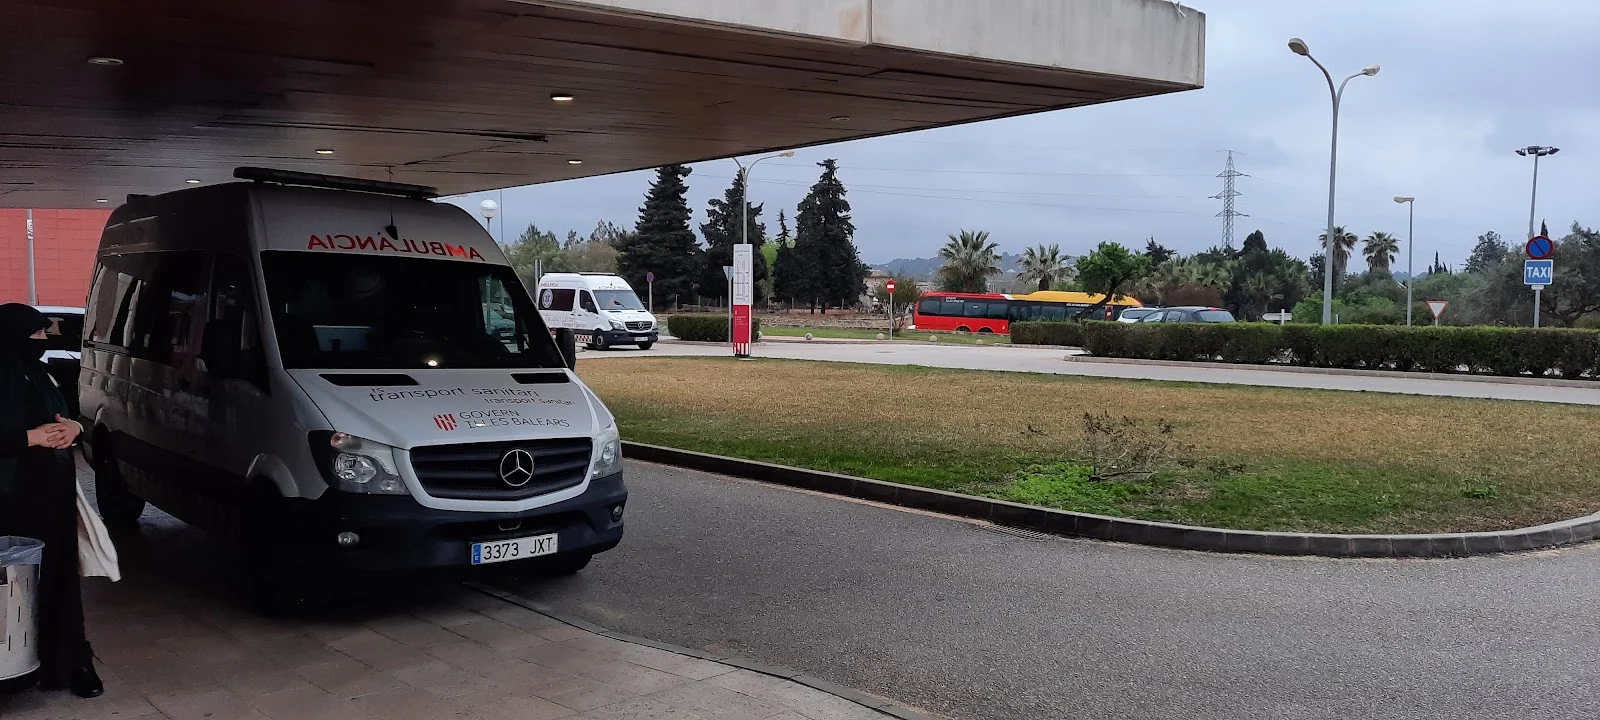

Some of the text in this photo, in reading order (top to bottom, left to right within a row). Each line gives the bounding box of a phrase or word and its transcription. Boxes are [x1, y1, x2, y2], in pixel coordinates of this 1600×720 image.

[1526, 266, 1551, 278] TAXI
[369, 387, 540, 402] transport sanitari
[459, 409, 520, 419] GOVERN
[511, 417, 570, 428] BALEARS
[483, 542, 519, 560] 3373
[529, 537, 553, 554] JXT
